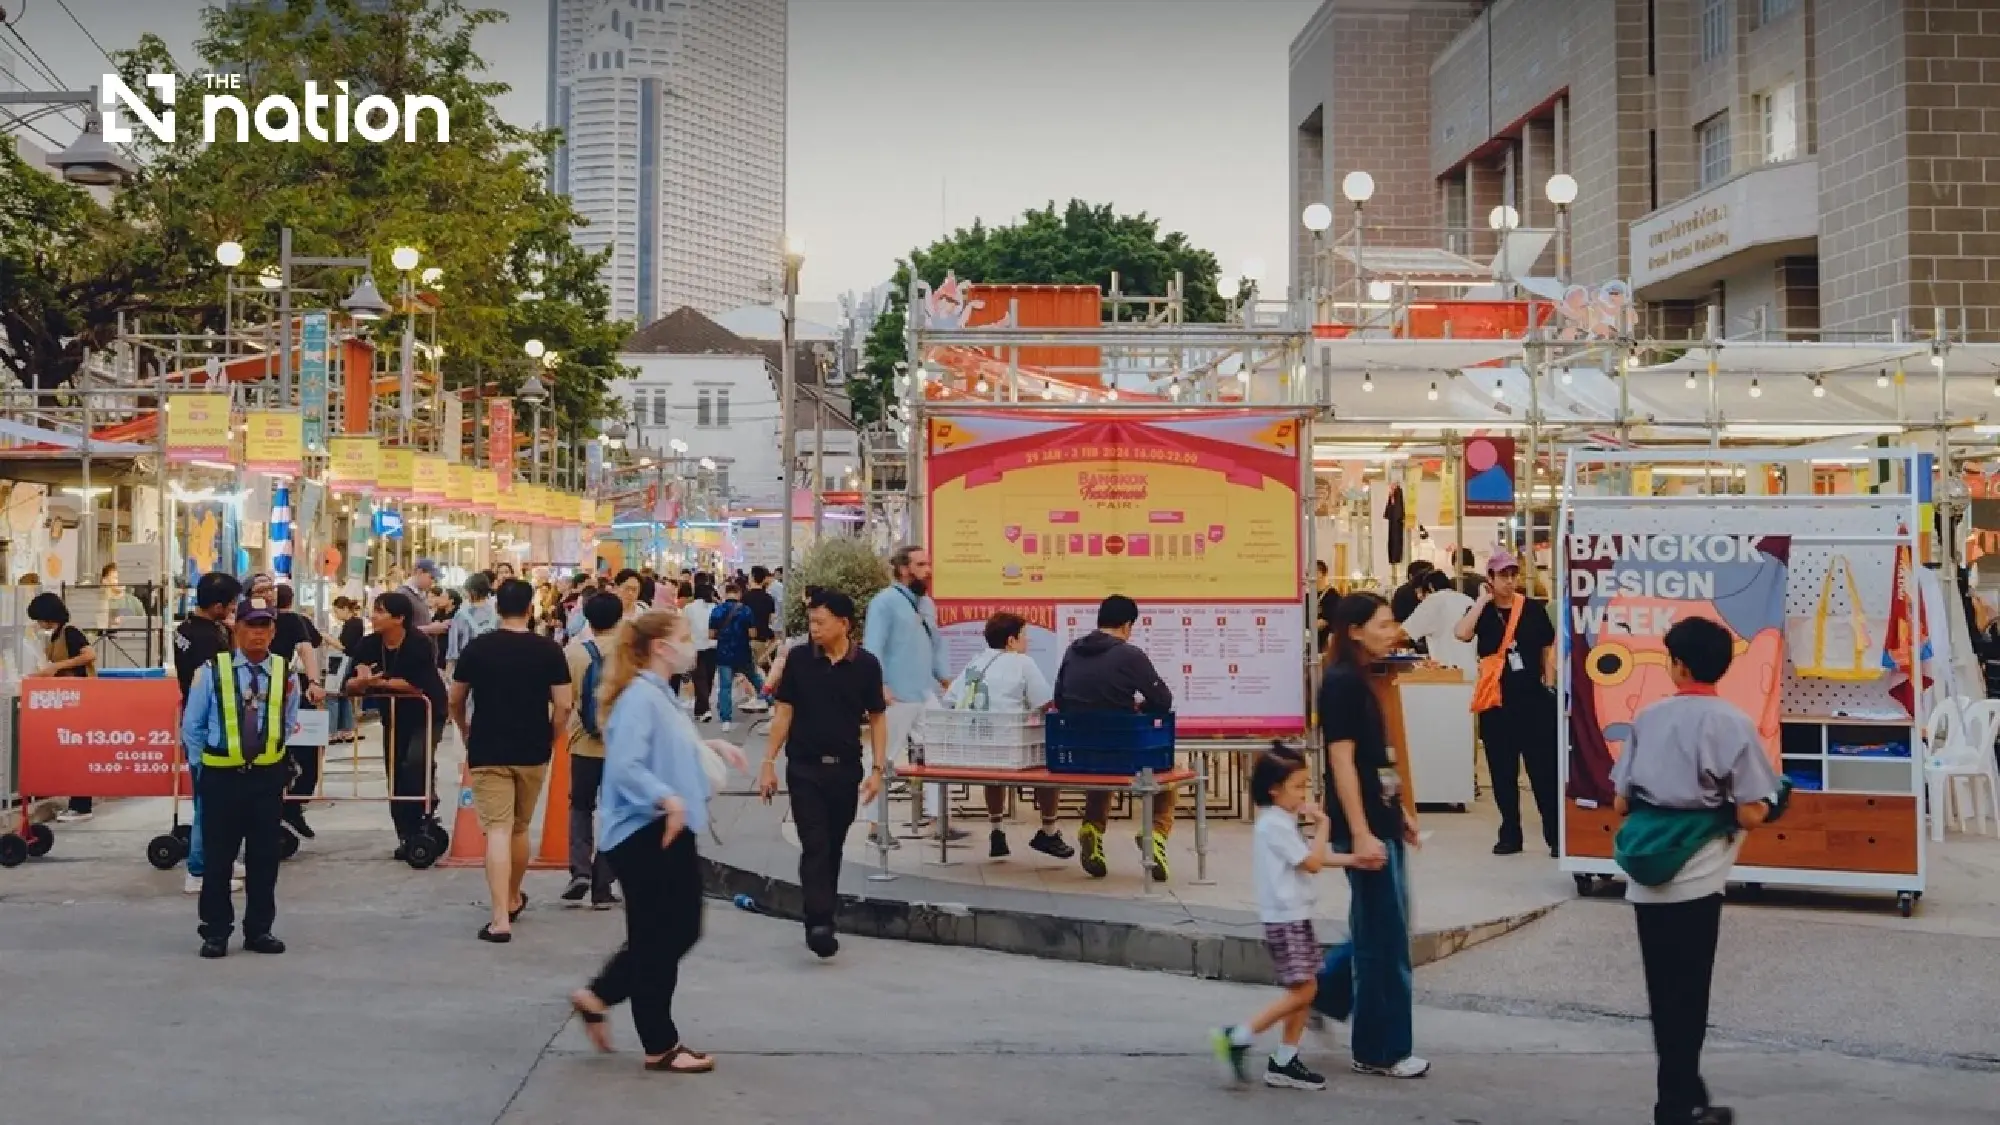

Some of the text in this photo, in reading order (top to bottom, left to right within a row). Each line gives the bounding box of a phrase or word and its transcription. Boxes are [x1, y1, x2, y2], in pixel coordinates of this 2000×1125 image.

[1078, 471, 1149, 486] BANGKOK
[1570, 535, 1766, 563] BANGKOK
[1570, 568, 1715, 600] DESIGN
[940, 607, 958, 625] UN
[1571, 605, 1679, 635] WEEK
[85, 730, 135, 745] 13.00
[148, 730, 175, 745] 22.
[115, 751, 164, 761] CLOSED
[134, 762, 169, 773] 22.00
